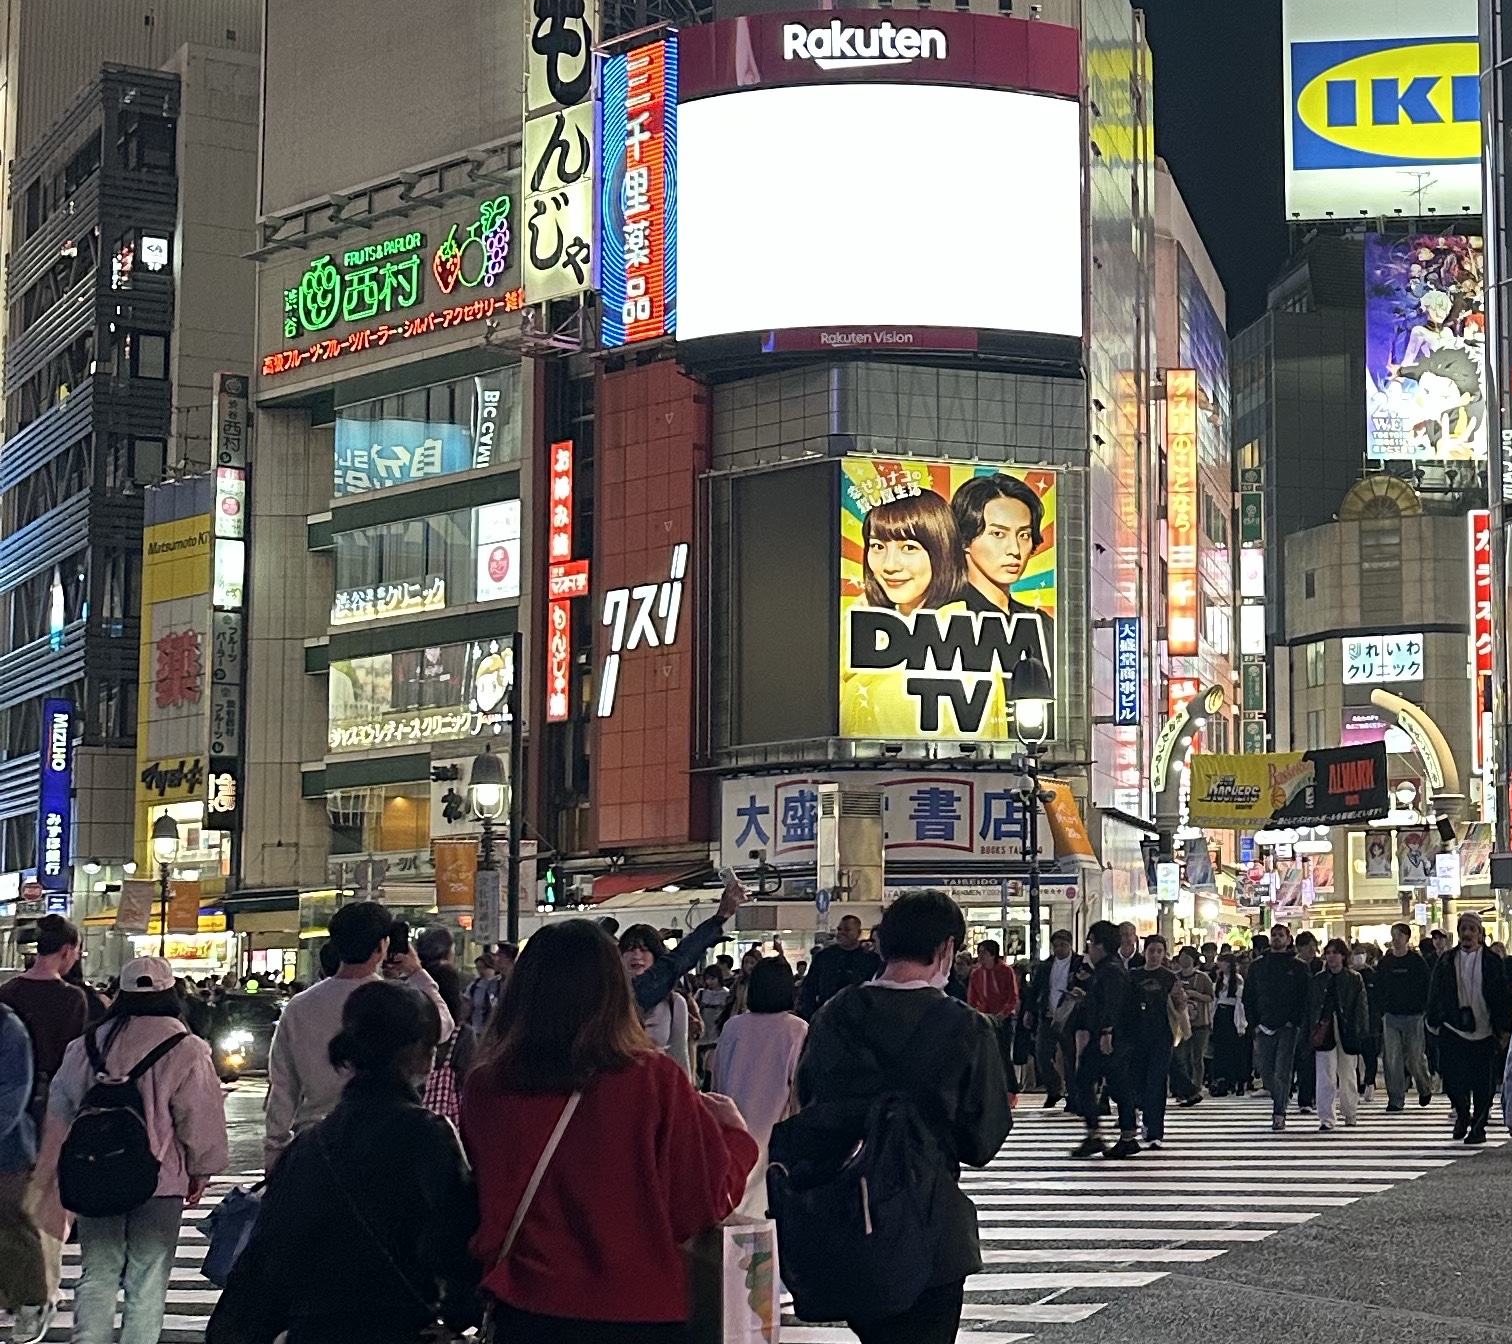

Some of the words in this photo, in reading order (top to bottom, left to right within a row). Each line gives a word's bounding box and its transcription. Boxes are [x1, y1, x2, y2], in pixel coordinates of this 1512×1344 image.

[783, 19, 946, 60] Rakuten
[623, 56, 655, 325] 三千里薬品
[343, 255, 421, 322] 西村
[821, 330, 872, 345] Rakuten
[874, 330, 913, 344] Vision
[484, 390, 500, 419] BIC
[148, 537, 197, 556] Matsumoto
[850, 609, 1049, 672] DMM
[1365, 640, 1421, 659] れいわ
[156, 631, 201, 707] 薬
[1120, 623, 1136, 721] 大盛堂商事ビル
[1347, 661, 1421, 679] クリニック
[907, 678, 992, 732] TV
[52, 713, 69, 771] MIZUHO
[735, 787, 1030, 849] 大盛書店
[980, 846, 1006, 855] BOOKS
